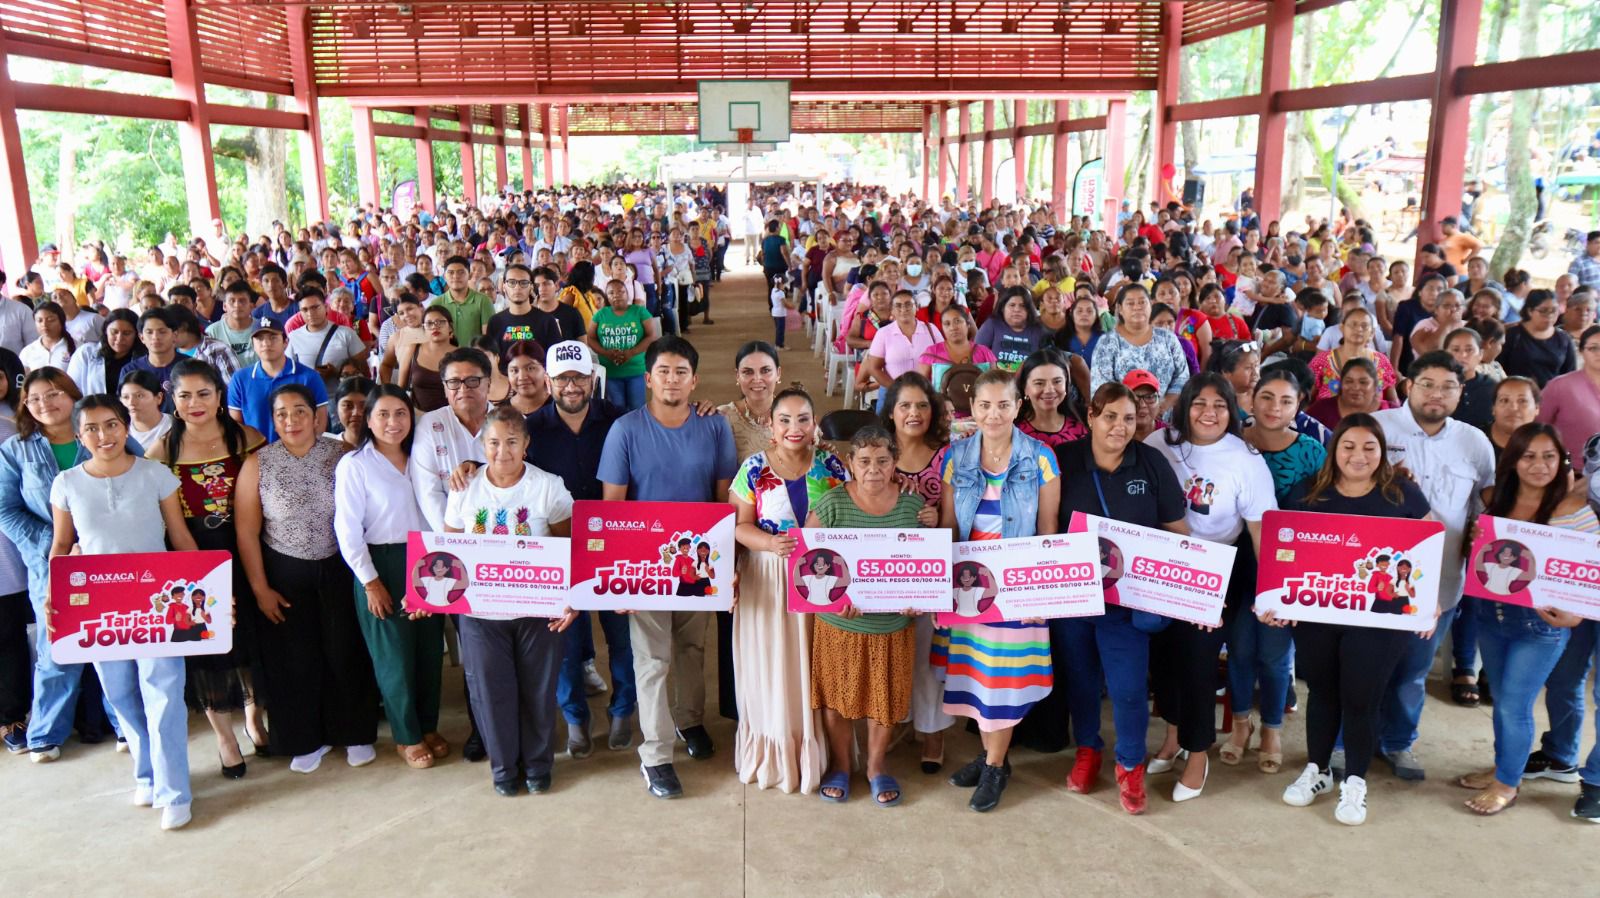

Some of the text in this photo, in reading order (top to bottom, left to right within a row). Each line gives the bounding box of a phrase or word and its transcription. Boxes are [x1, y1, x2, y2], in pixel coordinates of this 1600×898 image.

[1084, 179, 1095, 215] Joven
[503, 331, 533, 341] MARIO
[505, 325, 530, 333] SUPER
[605, 326, 632, 336] PADDY
[602, 334, 637, 345] STARTED
[556, 345, 581, 353] PACO
[605, 520, 646, 528] OAXACA
[1110, 525, 1141, 537] OAXACA
[1297, 531, 1341, 542] OAXACA
[1520, 527, 1553, 537] OAXACA
[971, 544, 1002, 552] OAXACA
[479, 565, 561, 581] $5,000.00
[617, 563, 671, 579] Tarjeta
[860, 560, 943, 577] $5,000.00
[1006, 566, 1091, 585] $5,000.00
[1135, 558, 1219, 588] $5,000.00
[89, 572, 135, 582] OAXACA
[593, 570, 672, 595] Joven
[1307, 575, 1366, 592] Tarjeta
[1124, 571, 1147, 582] (CINCO
[1161, 581, 1182, 589] PESOS
[1184, 586, 1206, 595] 00/100
[1207, 591, 1224, 599] M.N.)
[1281, 581, 1366, 611] Joven
[104, 613, 164, 628] Tarjeta
[78, 622, 166, 648] Joven
